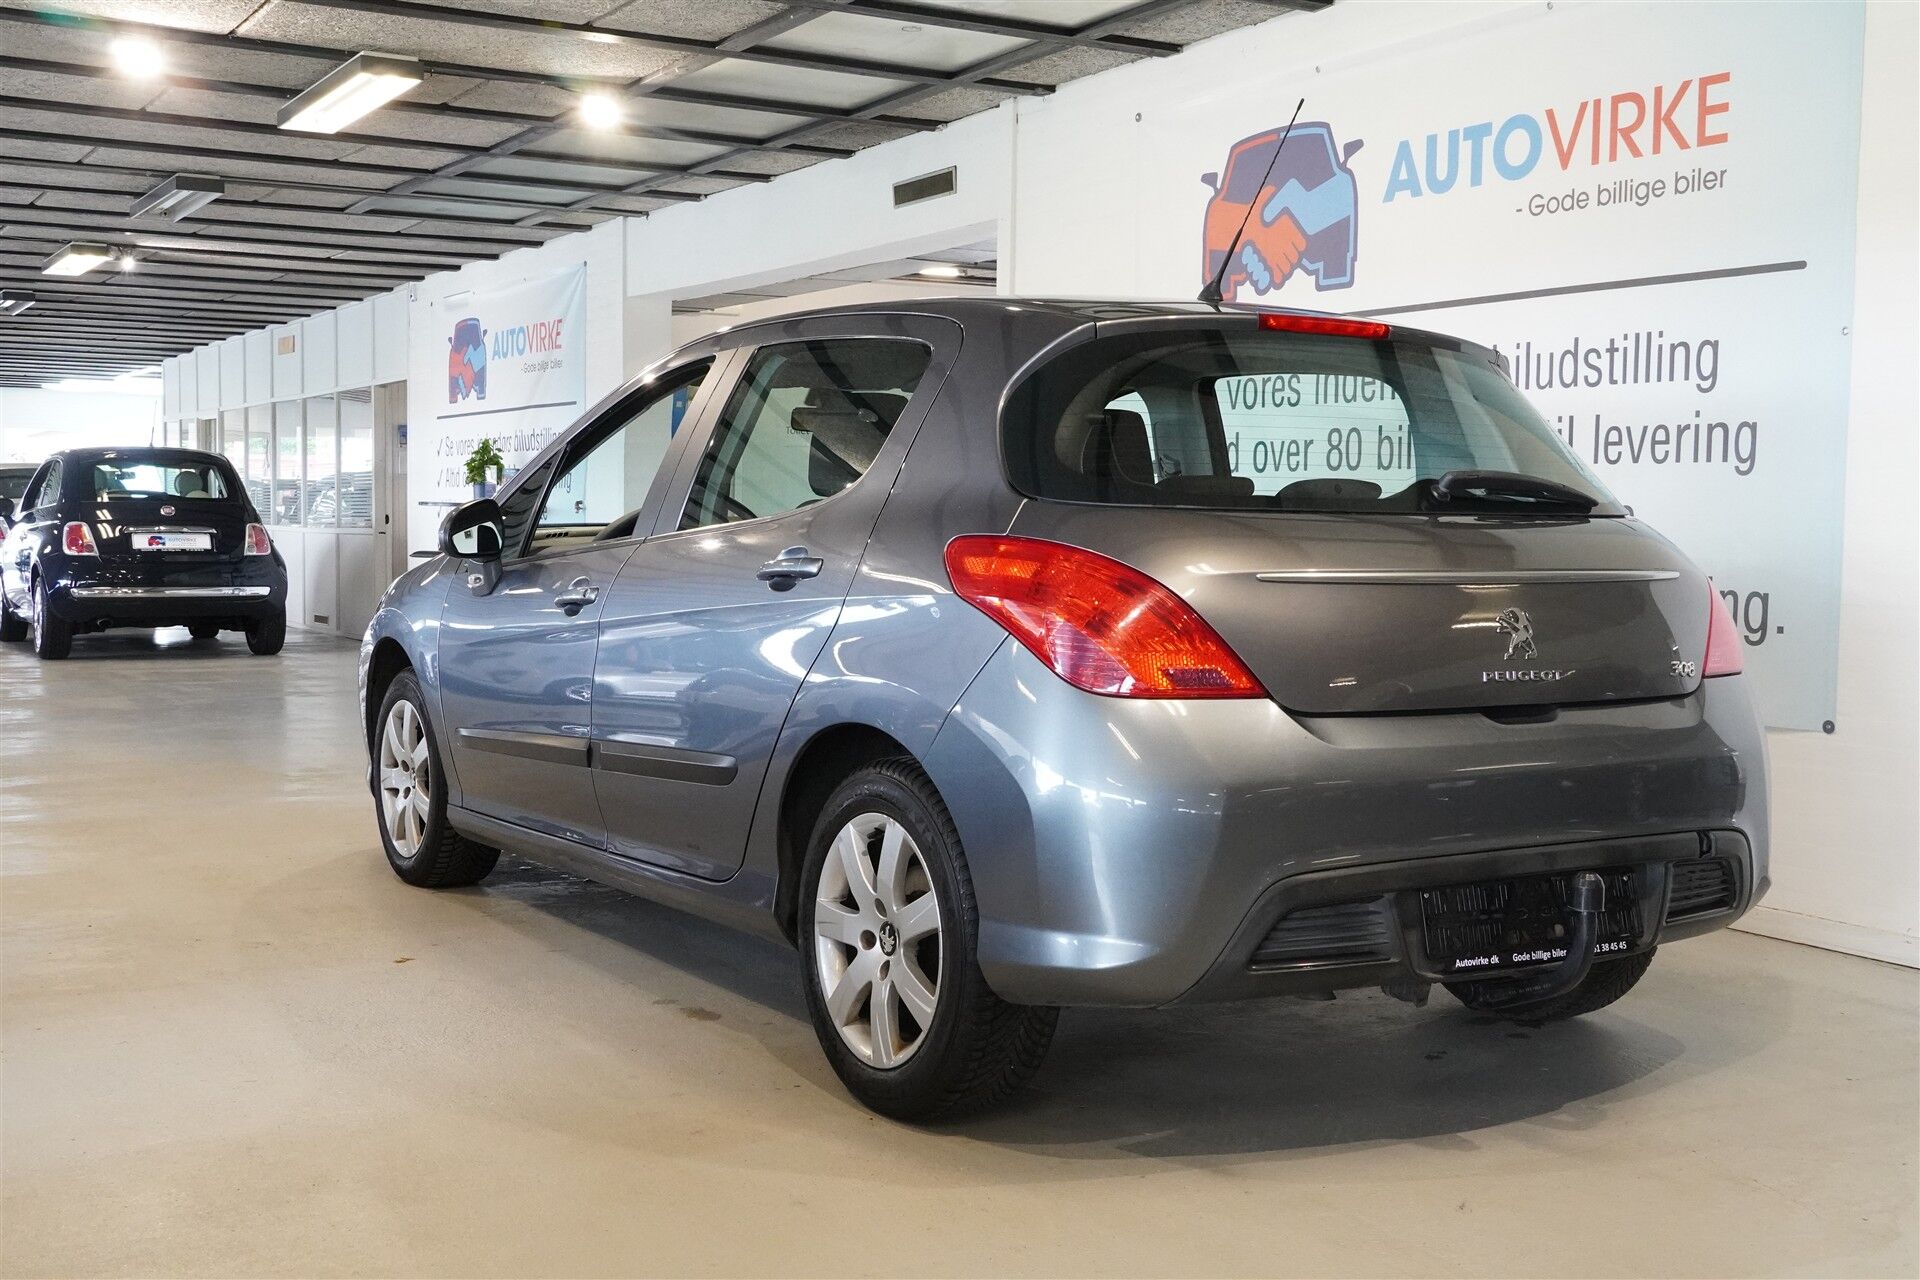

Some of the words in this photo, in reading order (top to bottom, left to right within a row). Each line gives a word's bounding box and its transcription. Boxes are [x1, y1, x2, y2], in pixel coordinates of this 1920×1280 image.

[1382, 72, 1730, 204] AUTOVIRKE
[1528, 188, 1590, 217] Gode
[1597, 178, 1666, 207] billige
[1674, 167, 1728, 195] biler
[492, 318, 563, 361] AUTOVIRKE
[1227, 374, 1301, 411] vores
[1493, 331, 1719, 394] iludstilling
[1253, 438, 1314, 474] over
[1326, 427, 1362, 472] 80
[1377, 424, 1412, 471] bil
[1593, 410, 1758, 476] levering
[1482, 670, 1562, 682] PEUGEOT
[1670, 660, 1696, 678] 308
[1455, 956, 1489, 968] Autovirke
[1512, 953, 1530, 962] Gode
[1531, 950, 1551, 961] billige
[1552, 948, 1567, 957] biler
[1601, 943, 1610, 952] 38
[1610, 941, 1618, 951] 45
[1619, 941, 1627, 950] 45
